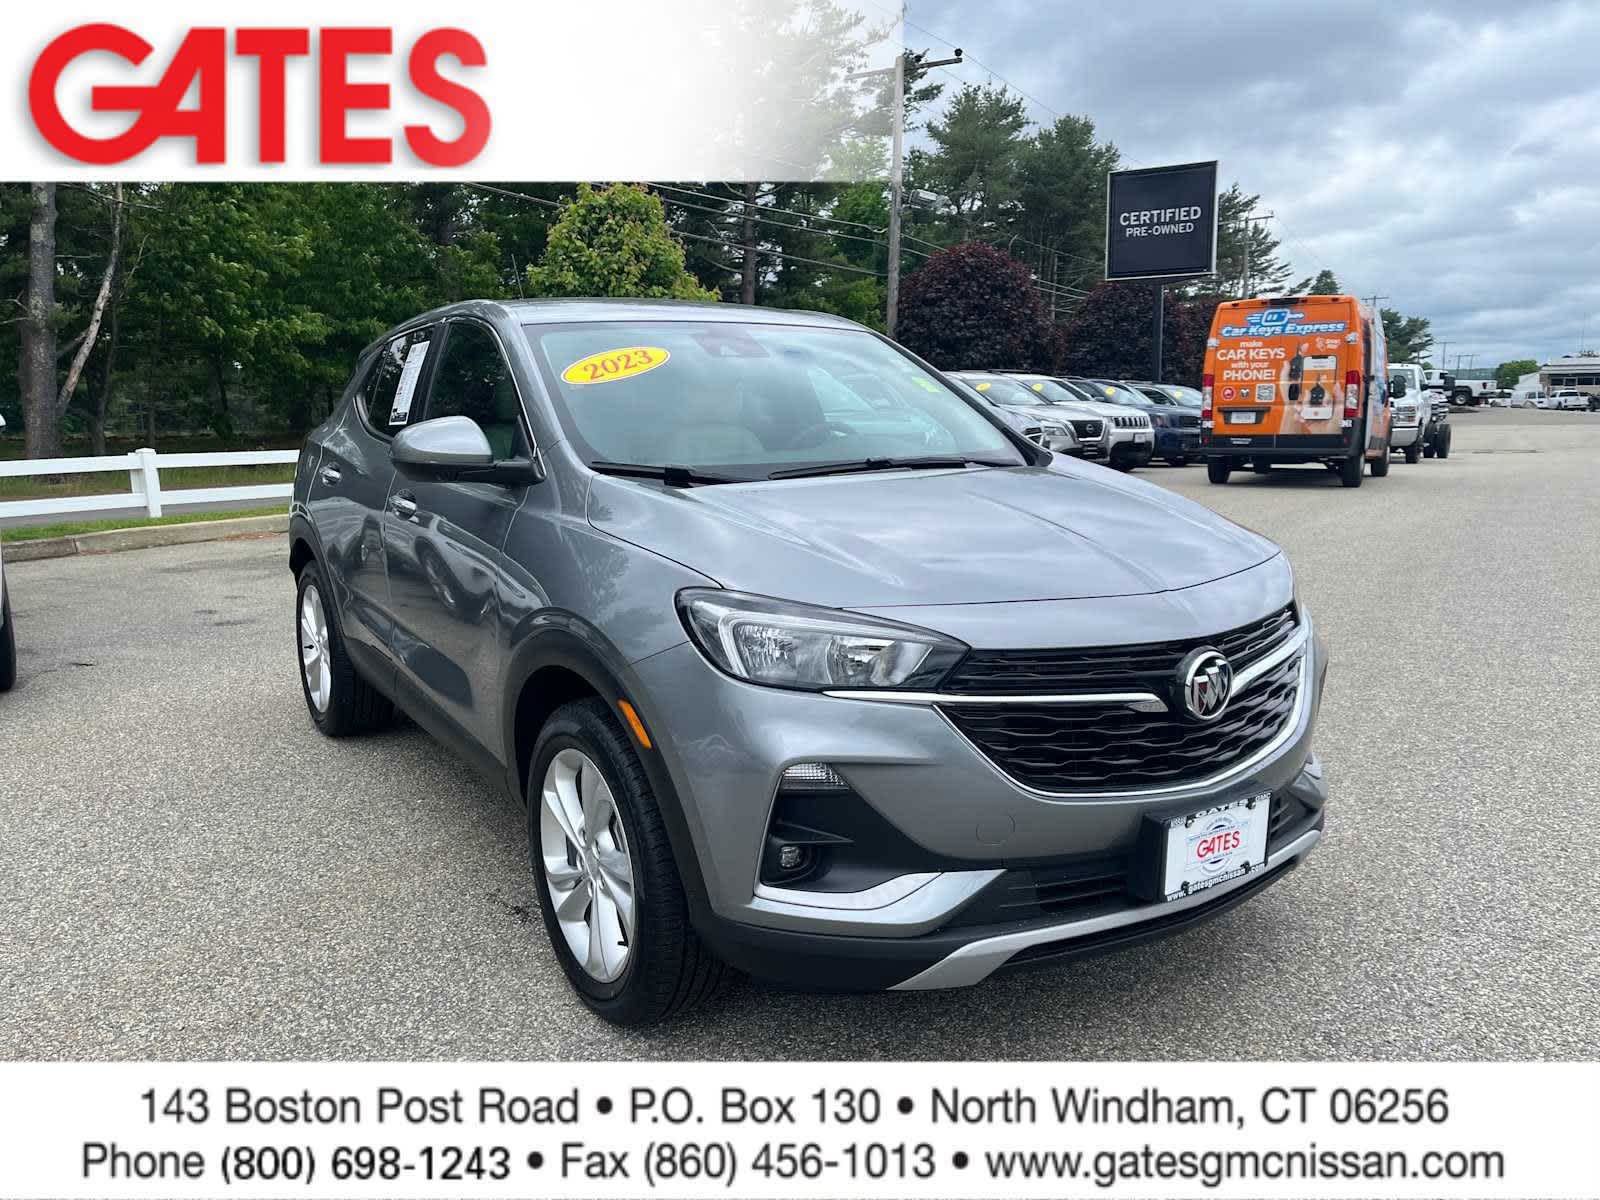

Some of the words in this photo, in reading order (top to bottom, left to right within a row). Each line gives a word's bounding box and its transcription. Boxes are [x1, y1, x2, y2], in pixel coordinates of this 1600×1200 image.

[1120, 206, 1201, 226] CERTIFIED
[1125, 223, 1194, 238] PRE-OWNED
[1222, 326, 1247, 337] Car
[1249, 325, 1282, 337] Keys
[1284, 322, 1345, 335] Express
[1240, 340, 1263, 348] make
[1216, 349, 1247, 361] CAR
[1249, 347, 1286, 360] KEYS
[583, 350, 654, 380] 2023
[1231, 361, 1249, 369] with
[1250, 361, 1270, 370] your
[1223, 369, 1276, 381] PHONE!
[1196, 830, 1241, 858] GATES
